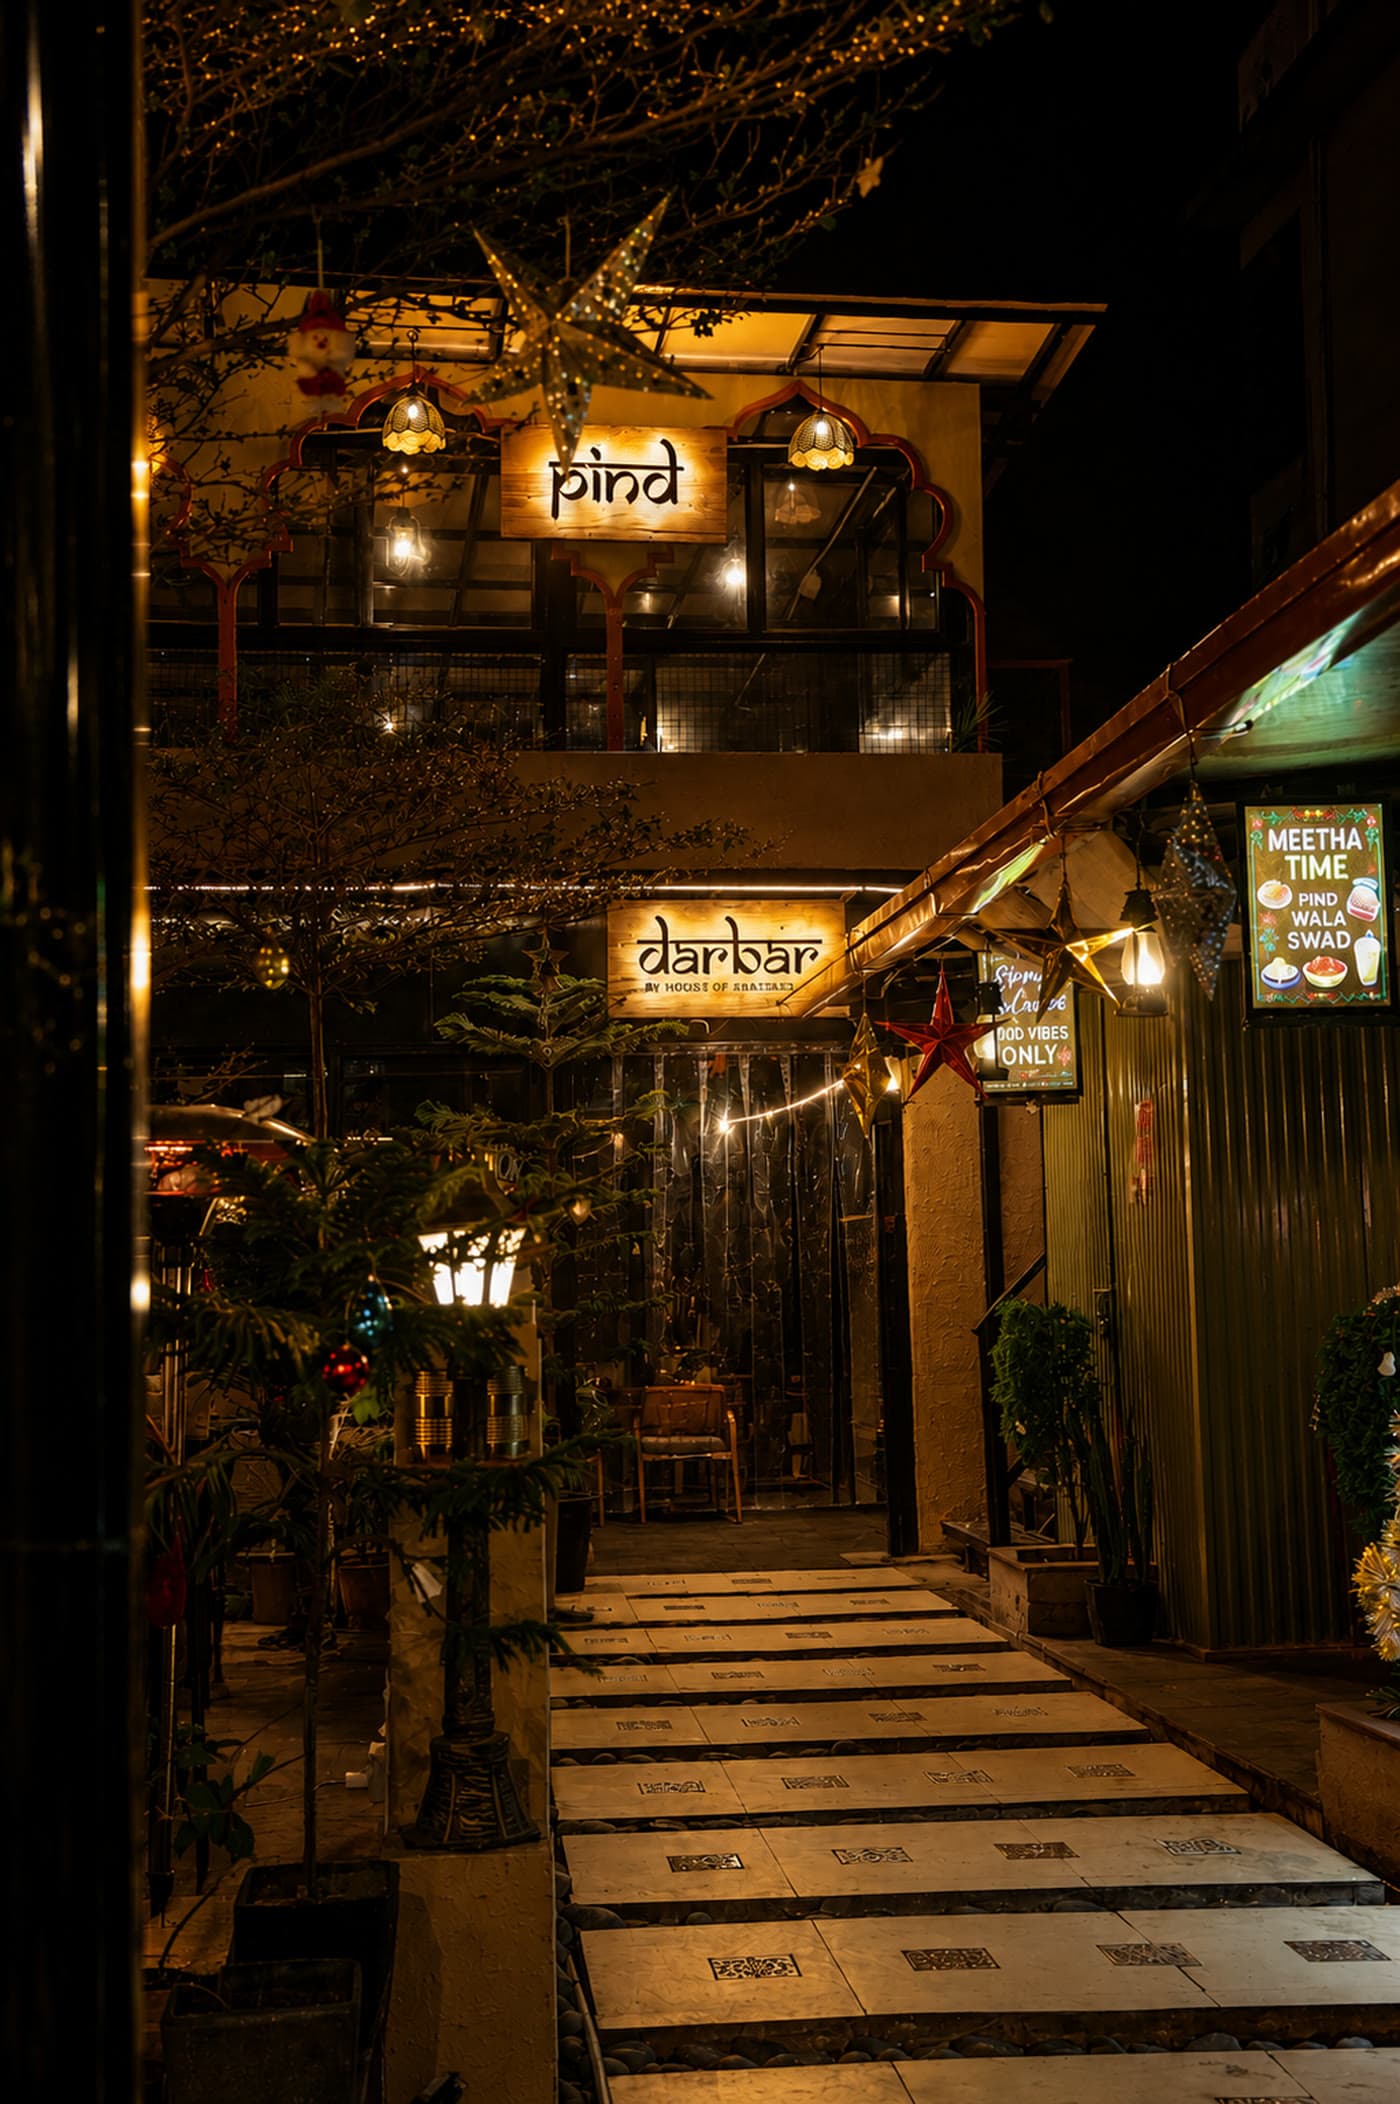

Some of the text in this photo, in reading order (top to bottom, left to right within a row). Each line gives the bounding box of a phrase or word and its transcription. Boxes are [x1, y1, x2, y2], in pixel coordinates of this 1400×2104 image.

[548, 439, 684, 520] pind
[1268, 827, 1363, 852] MEETHA
[1284, 854, 1349, 881] TIME
[1298, 892, 1338, 906] PIND
[1291, 910, 1347, 927] WALA
[637, 915, 823, 975] darbar
[1287, 931, 1351, 950] SWAD
[712, 982, 728, 992] OF
[997, 1026, 1069, 1041] OOD VIBES
[1002, 1044, 1058, 1065] ONLY
